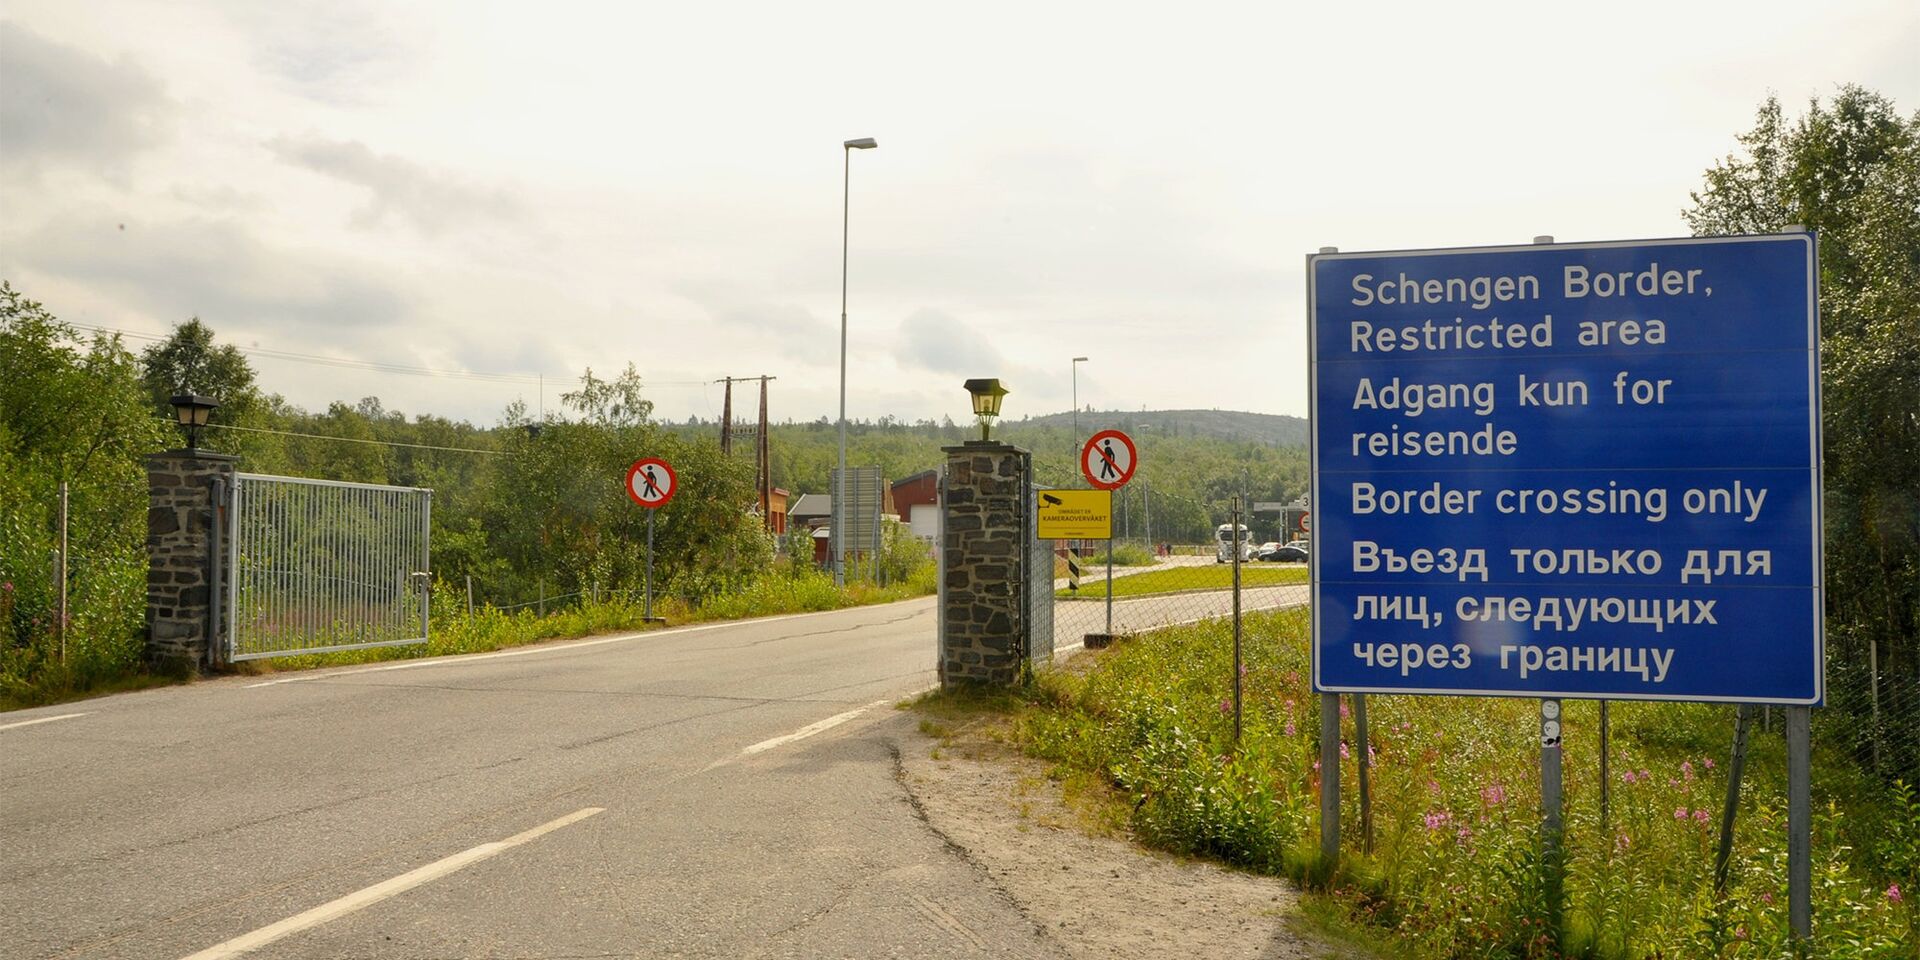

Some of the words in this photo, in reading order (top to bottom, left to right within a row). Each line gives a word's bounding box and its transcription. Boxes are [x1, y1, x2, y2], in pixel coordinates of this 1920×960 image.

[1351, 272, 1539, 309] Schengen
[1564, 262, 1712, 298] Border,
[1351, 315, 1553, 352] Restricted
[1577, 319, 1666, 347] area
[1352, 377, 1495, 416] Adgang
[1519, 374, 1588, 407] kun
[1613, 371, 1673, 405] for
[1352, 422, 1518, 457] reisende
[1043, 514, 1106, 522] KAMERAOVERVÅKET
[1352, 481, 1482, 515] Border
[1495, 480, 1667, 522] crossing
[1683, 480, 1767, 522] only
[1352, 540, 1489, 581] Въезд
[1510, 548, 1662, 575] только
[1681, 549, 1771, 584] для
[1353, 595, 1443, 628] лиц,
[1455, 596, 1718, 632] следующих
[1353, 642, 1472, 677] через
[1499, 642, 1675, 682] границу
